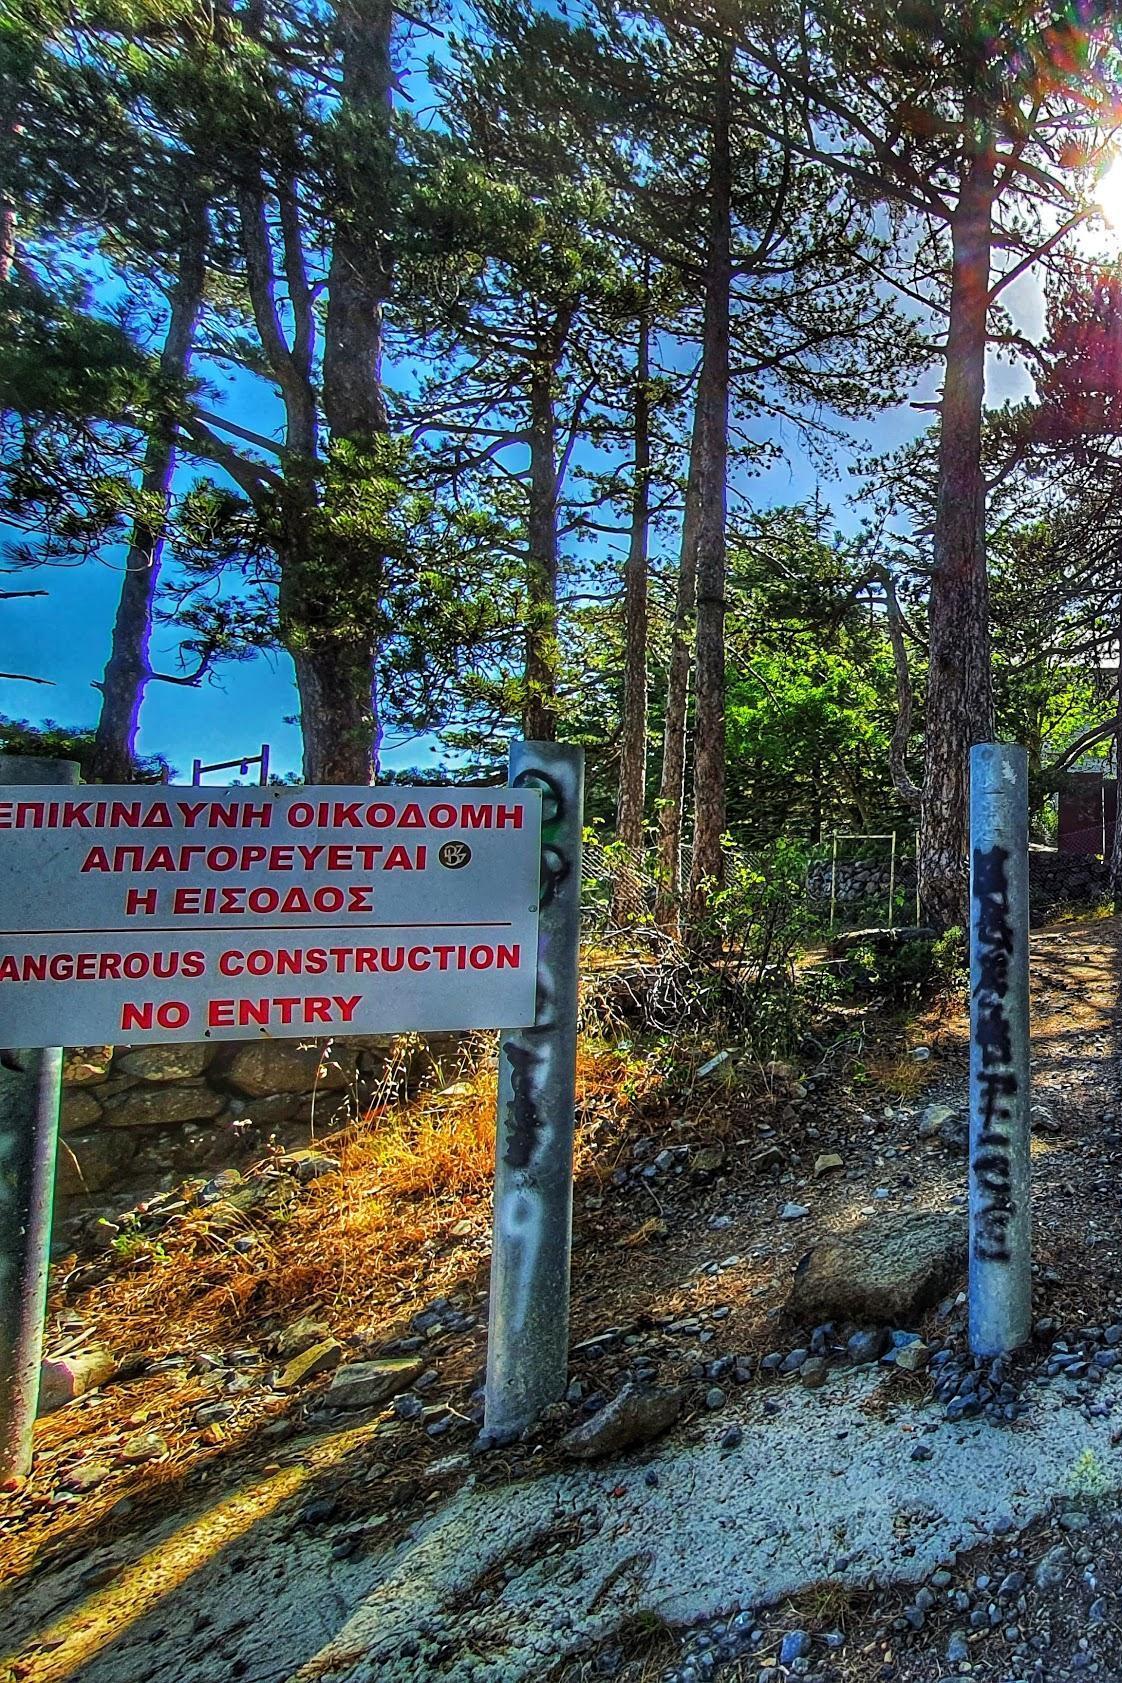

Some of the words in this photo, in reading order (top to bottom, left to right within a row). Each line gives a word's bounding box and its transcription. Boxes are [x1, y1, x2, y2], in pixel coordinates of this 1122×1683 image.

[0, 801, 272, 829] ΕΠΙΚΙΝΔΥΝΗ
[287, 802, 524, 830] ΟΙΚΟΔΟΜΗ
[80, 844, 427, 873] ΑΠΑΓΟΡΕΥΕΤΑΙ
[126, 887, 158, 915] Η
[173, 886, 374, 915] ΕΙΣΟΔΟΣ
[219, 944, 521, 976] CONSTRUCTION
[121, 1002, 190, 1030] NO
[208, 995, 363, 1027] ENTRY
